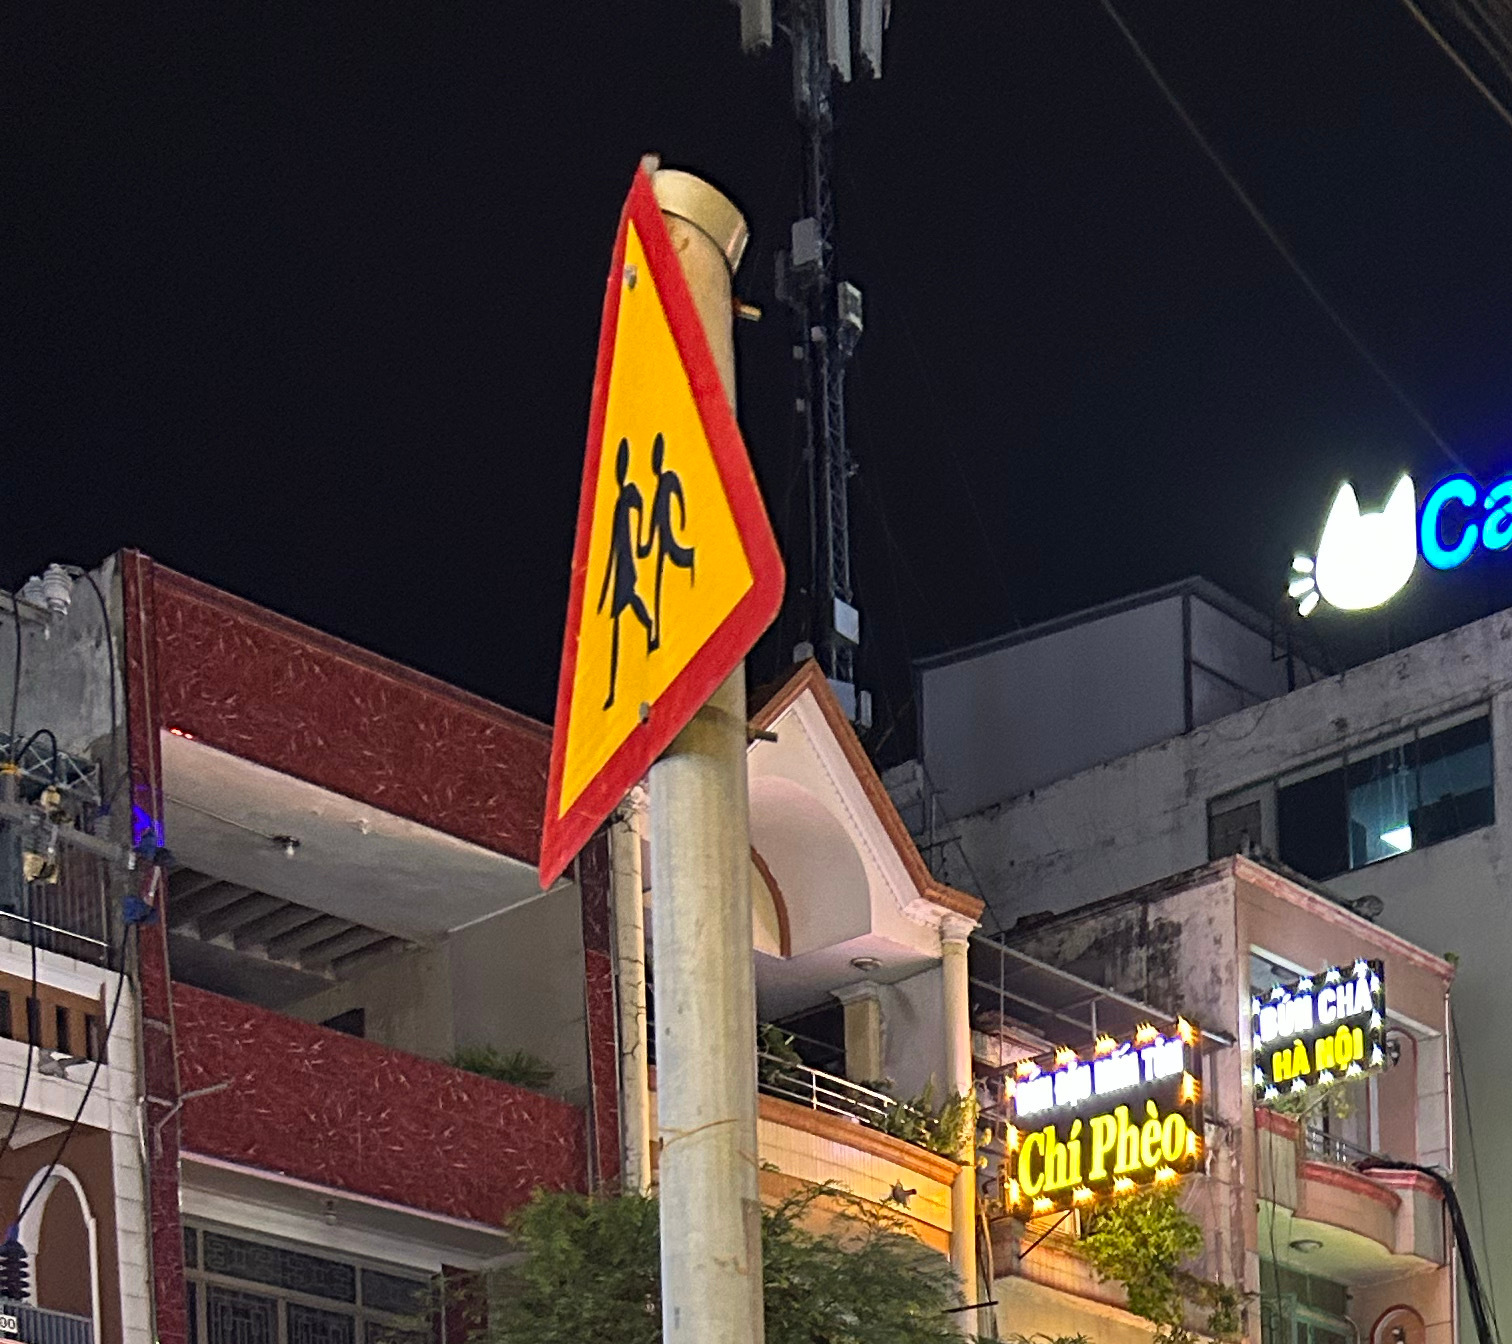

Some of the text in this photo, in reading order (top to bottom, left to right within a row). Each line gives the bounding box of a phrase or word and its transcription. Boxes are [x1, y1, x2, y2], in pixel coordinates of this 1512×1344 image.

[1273, 1025, 1364, 1082] HÀ NỘI
[1018, 1100, 1186, 1196] Chí Phèo
